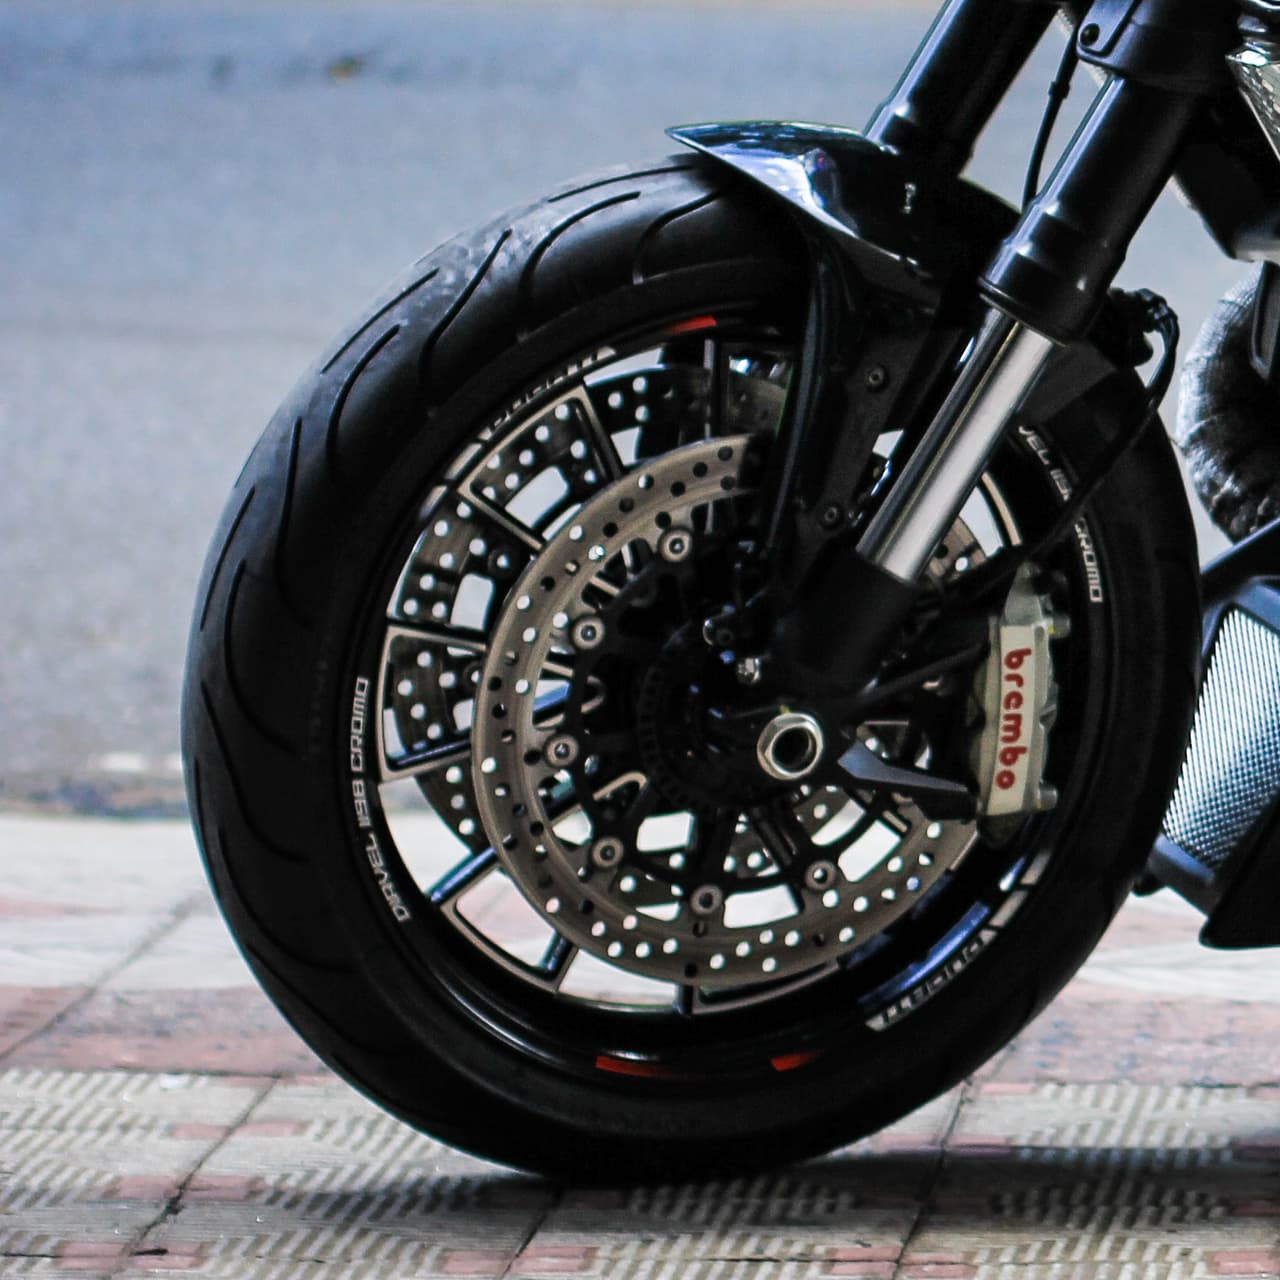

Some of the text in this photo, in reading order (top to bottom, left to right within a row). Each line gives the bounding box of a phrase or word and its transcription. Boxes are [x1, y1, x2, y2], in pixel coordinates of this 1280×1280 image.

[351, 677, 370, 771] CROMO
[996, 648, 1032, 790] brembo
[364, 833, 411, 922] DIAVEL
